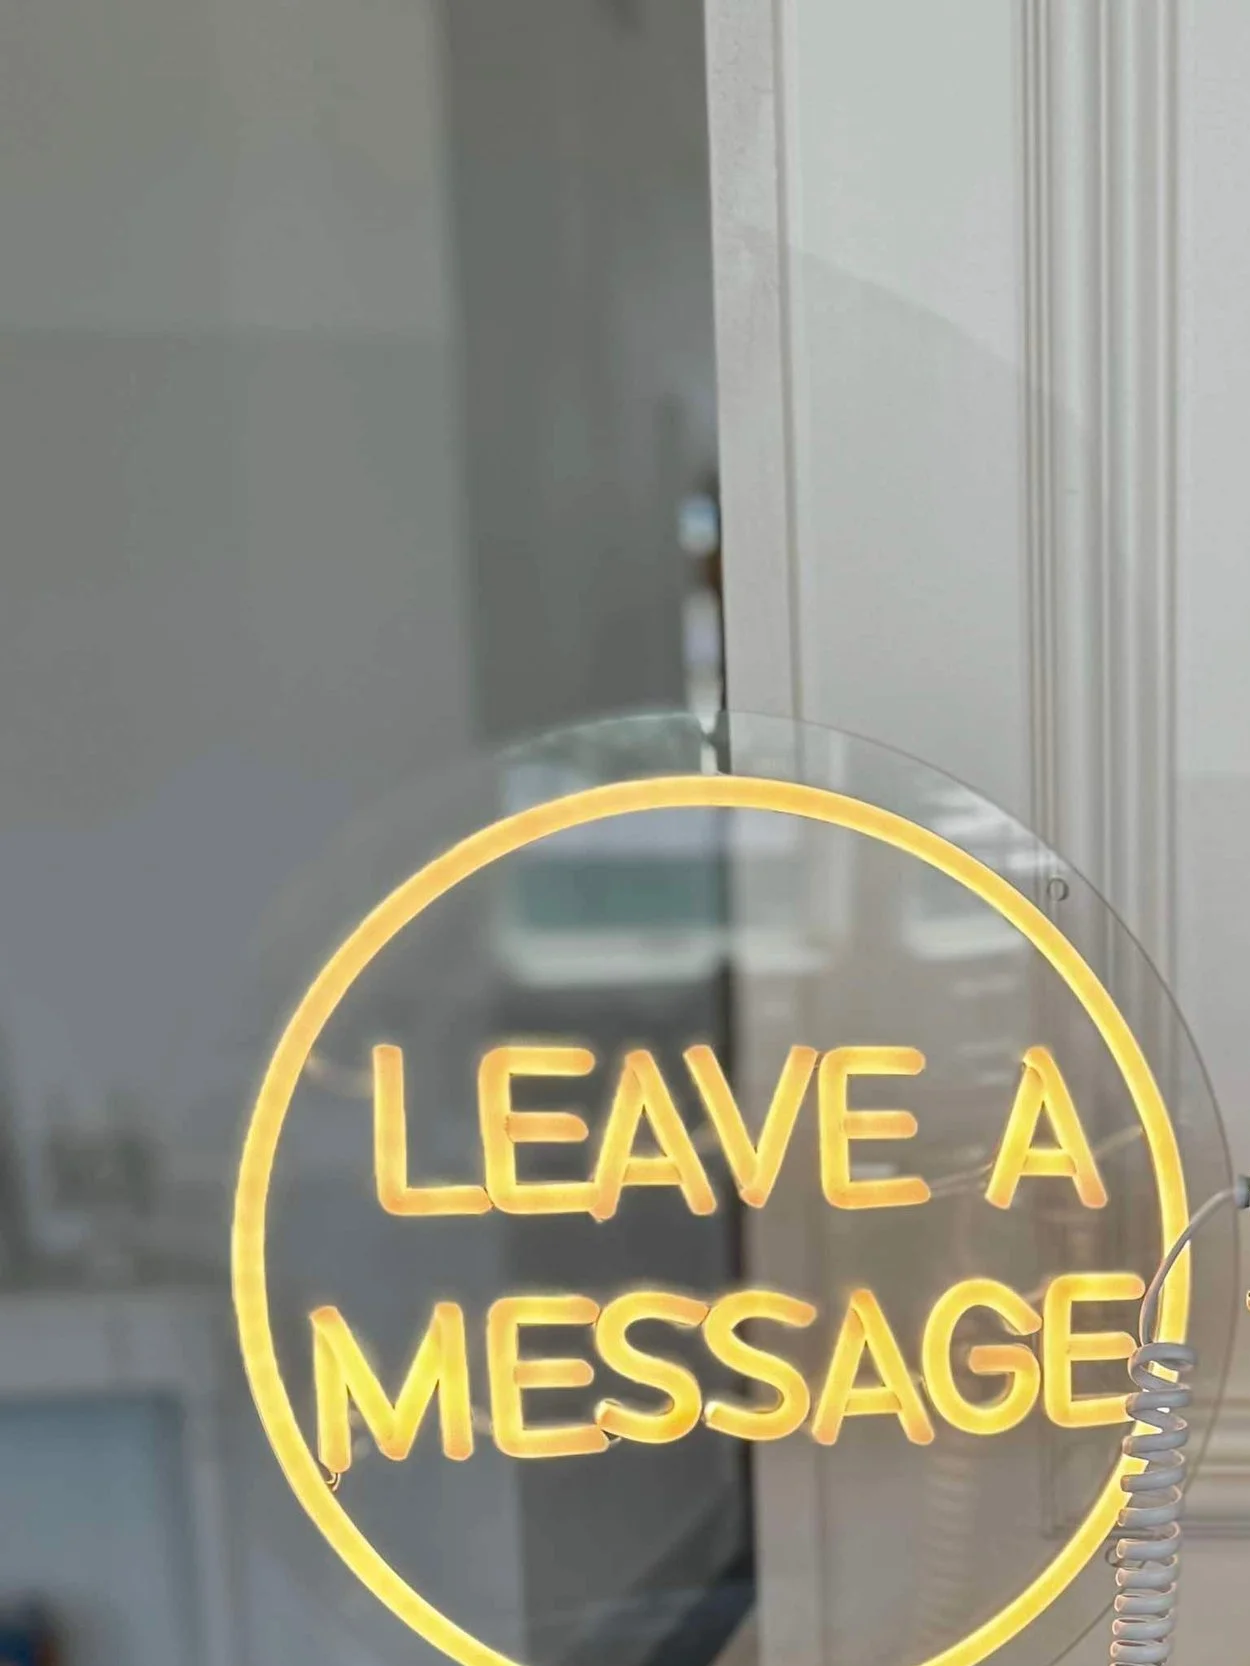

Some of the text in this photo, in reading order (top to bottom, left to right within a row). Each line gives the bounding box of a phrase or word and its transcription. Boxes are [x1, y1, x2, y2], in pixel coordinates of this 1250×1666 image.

[373, 1044, 1108, 1221] LEAVE A
[309, 1271, 1146, 1473] MESSAGE
